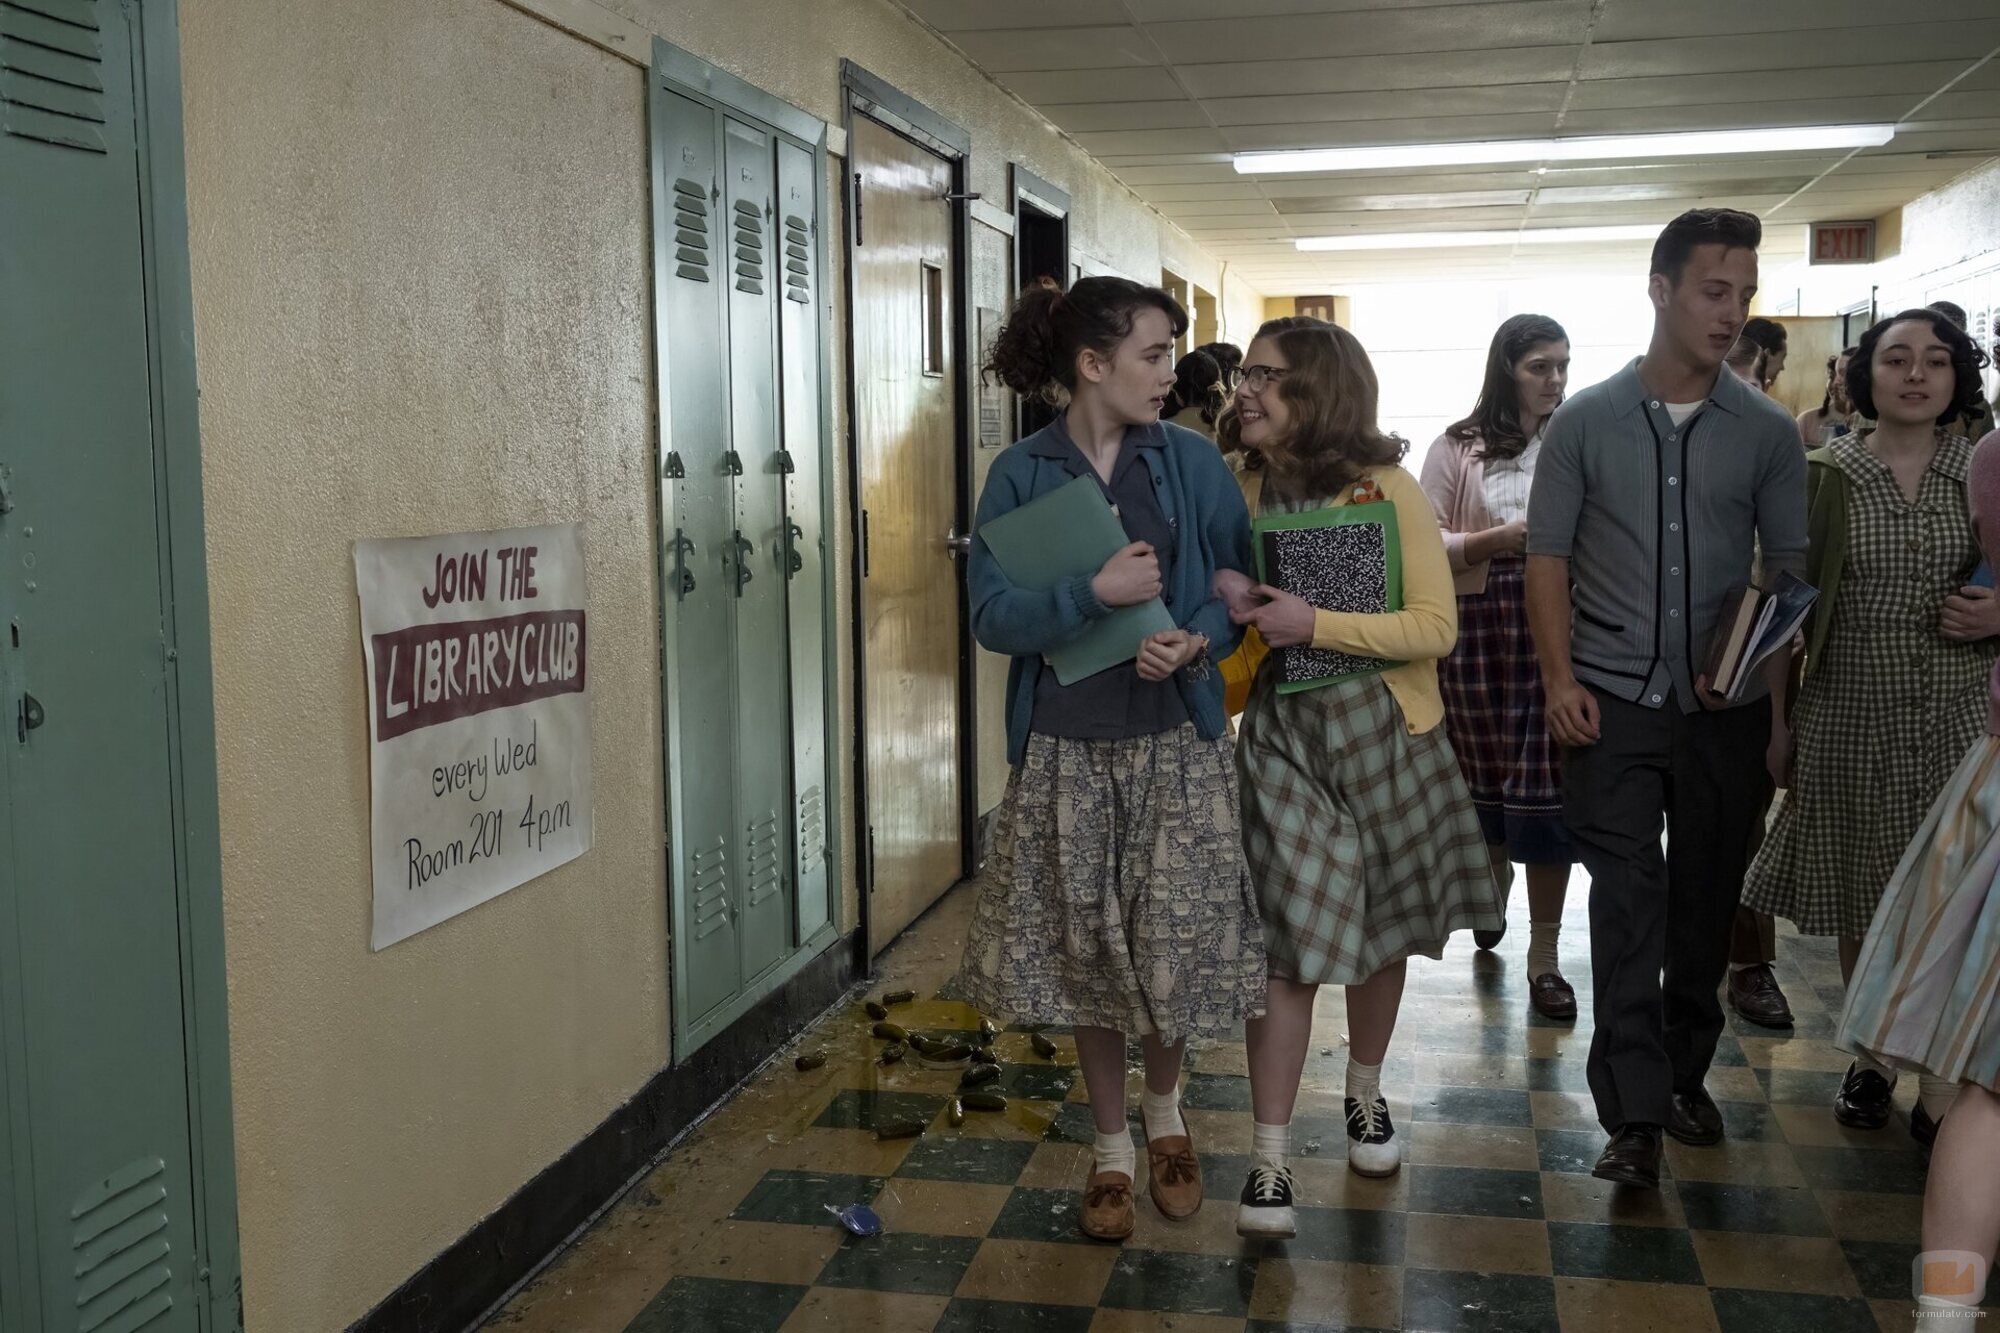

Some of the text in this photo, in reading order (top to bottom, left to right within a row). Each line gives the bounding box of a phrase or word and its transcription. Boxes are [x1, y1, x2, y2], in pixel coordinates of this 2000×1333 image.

[1816, 227, 1867, 260] EXIT
[422, 546, 538, 609] JOIN THE
[432, 719, 537, 802] every Wed
[403, 838, 463, 890] Room
[469, 809, 503, 863] 201
